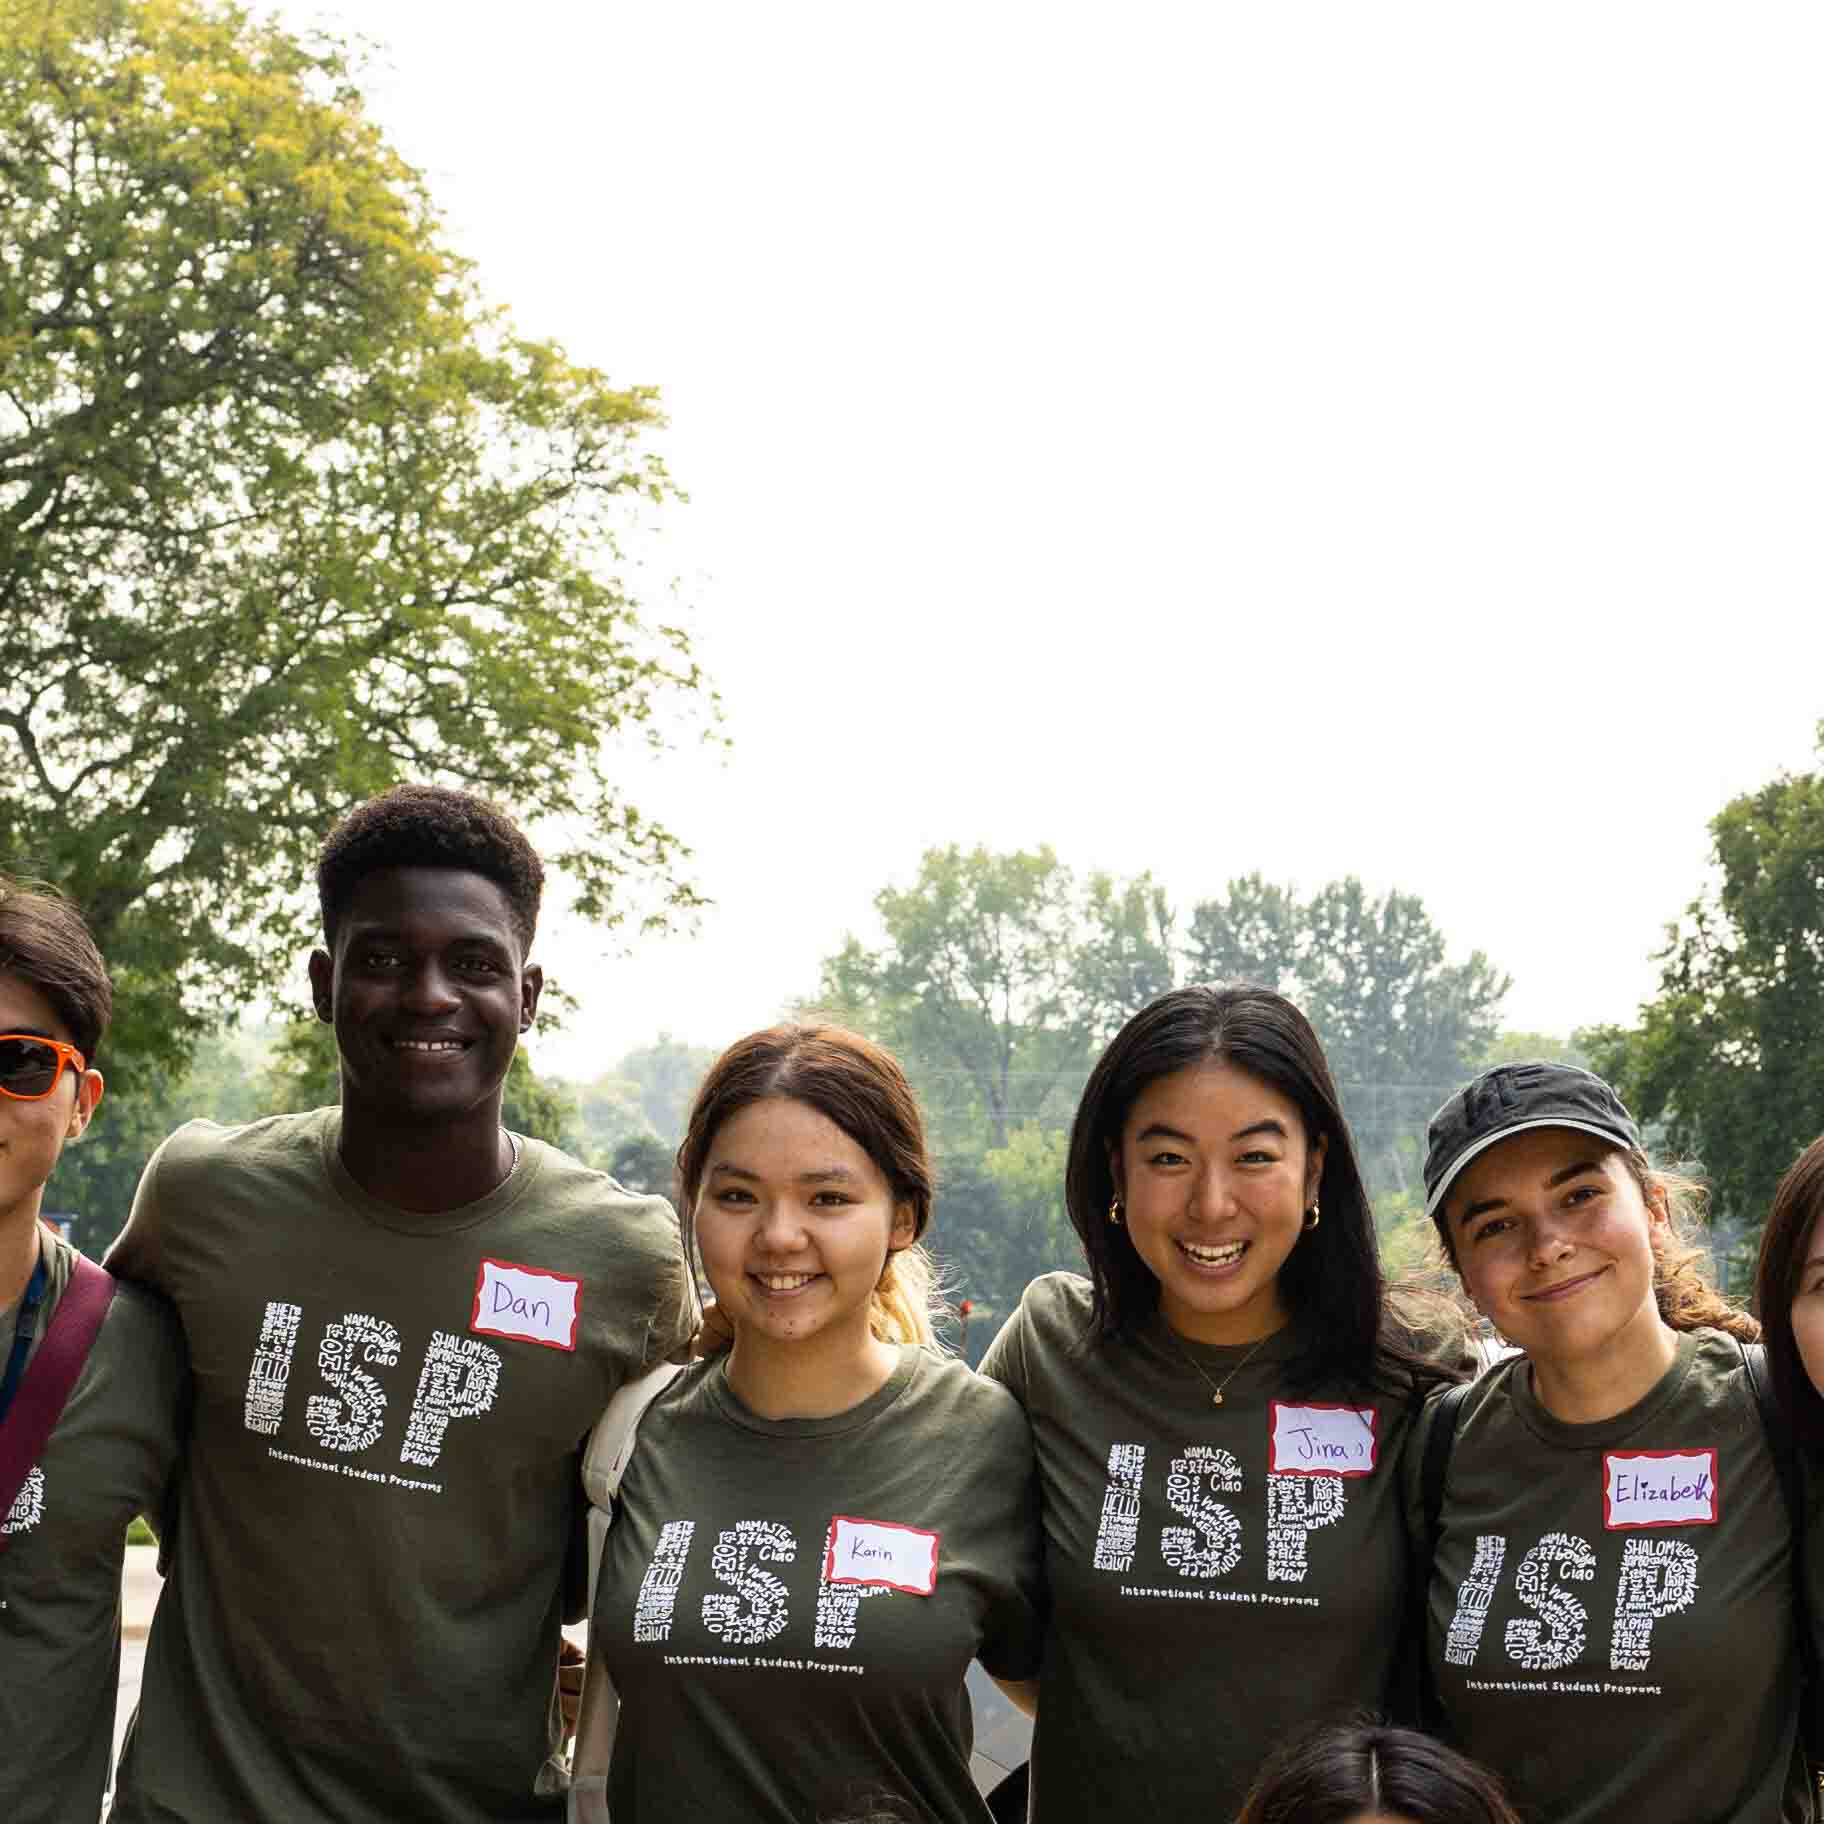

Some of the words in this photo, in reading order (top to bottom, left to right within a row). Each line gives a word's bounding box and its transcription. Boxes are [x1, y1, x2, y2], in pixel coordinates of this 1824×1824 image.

[493, 1280, 551, 1327] Dan
[243, 1301, 503, 1468] ISP
[268, 1447, 339, 1474] International
[342, 1464, 387, 1484] Student
[389, 1473, 443, 1494] Programs
[1616, 1473, 1711, 1503] Elizabeth
[1093, 1444, 1347, 1582] ISP
[851, 1535, 894, 1561] Karin
[1120, 1585, 1204, 1600] International
[1209, 1591, 1258, 1604] Student
[1261, 1594, 1320, 1607] Programs
[1444, 1532, 1700, 1672] ISP
[664, 1655, 750, 1667] International
[754, 1657, 804, 1670] Student
[807, 1661, 865, 1675] Programs
[1466, 1679, 1548, 1692] International
[1552, 1681, 1601, 1694] Student
[1604, 1683, 1662, 1695] Programs
